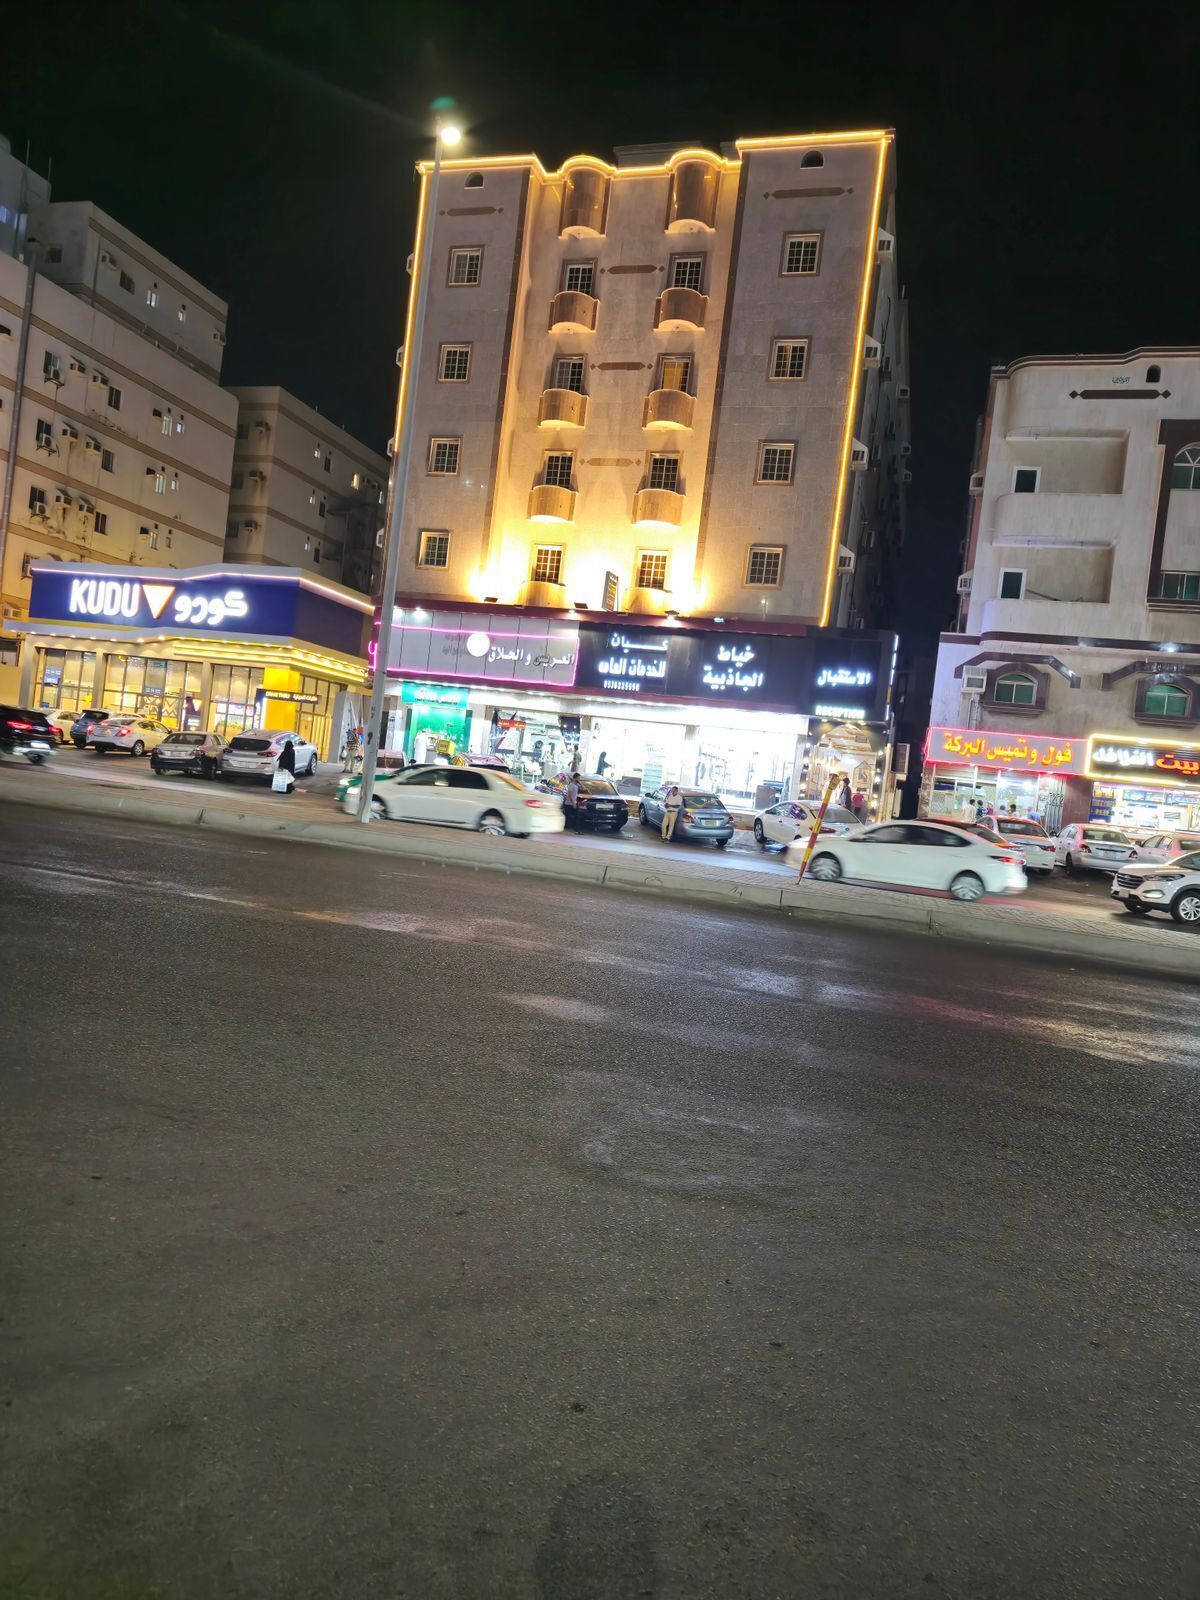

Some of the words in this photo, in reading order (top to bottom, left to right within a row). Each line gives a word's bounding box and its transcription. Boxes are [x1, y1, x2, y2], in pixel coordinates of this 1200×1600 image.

[70, 579, 140, 618] KUDU
[717, 645, 755, 667] خياط
[703, 665, 764, 692] الجاذبية
[817, 669, 871, 687] الاستقبال
[815, 705, 866, 719] RECEPTION
[944, 732, 986, 760] البركة
[1041, 742, 1072, 766] فول
[1092, 747, 1154, 767] الفلافل
[1155, 754, 1199, 775] بيت
